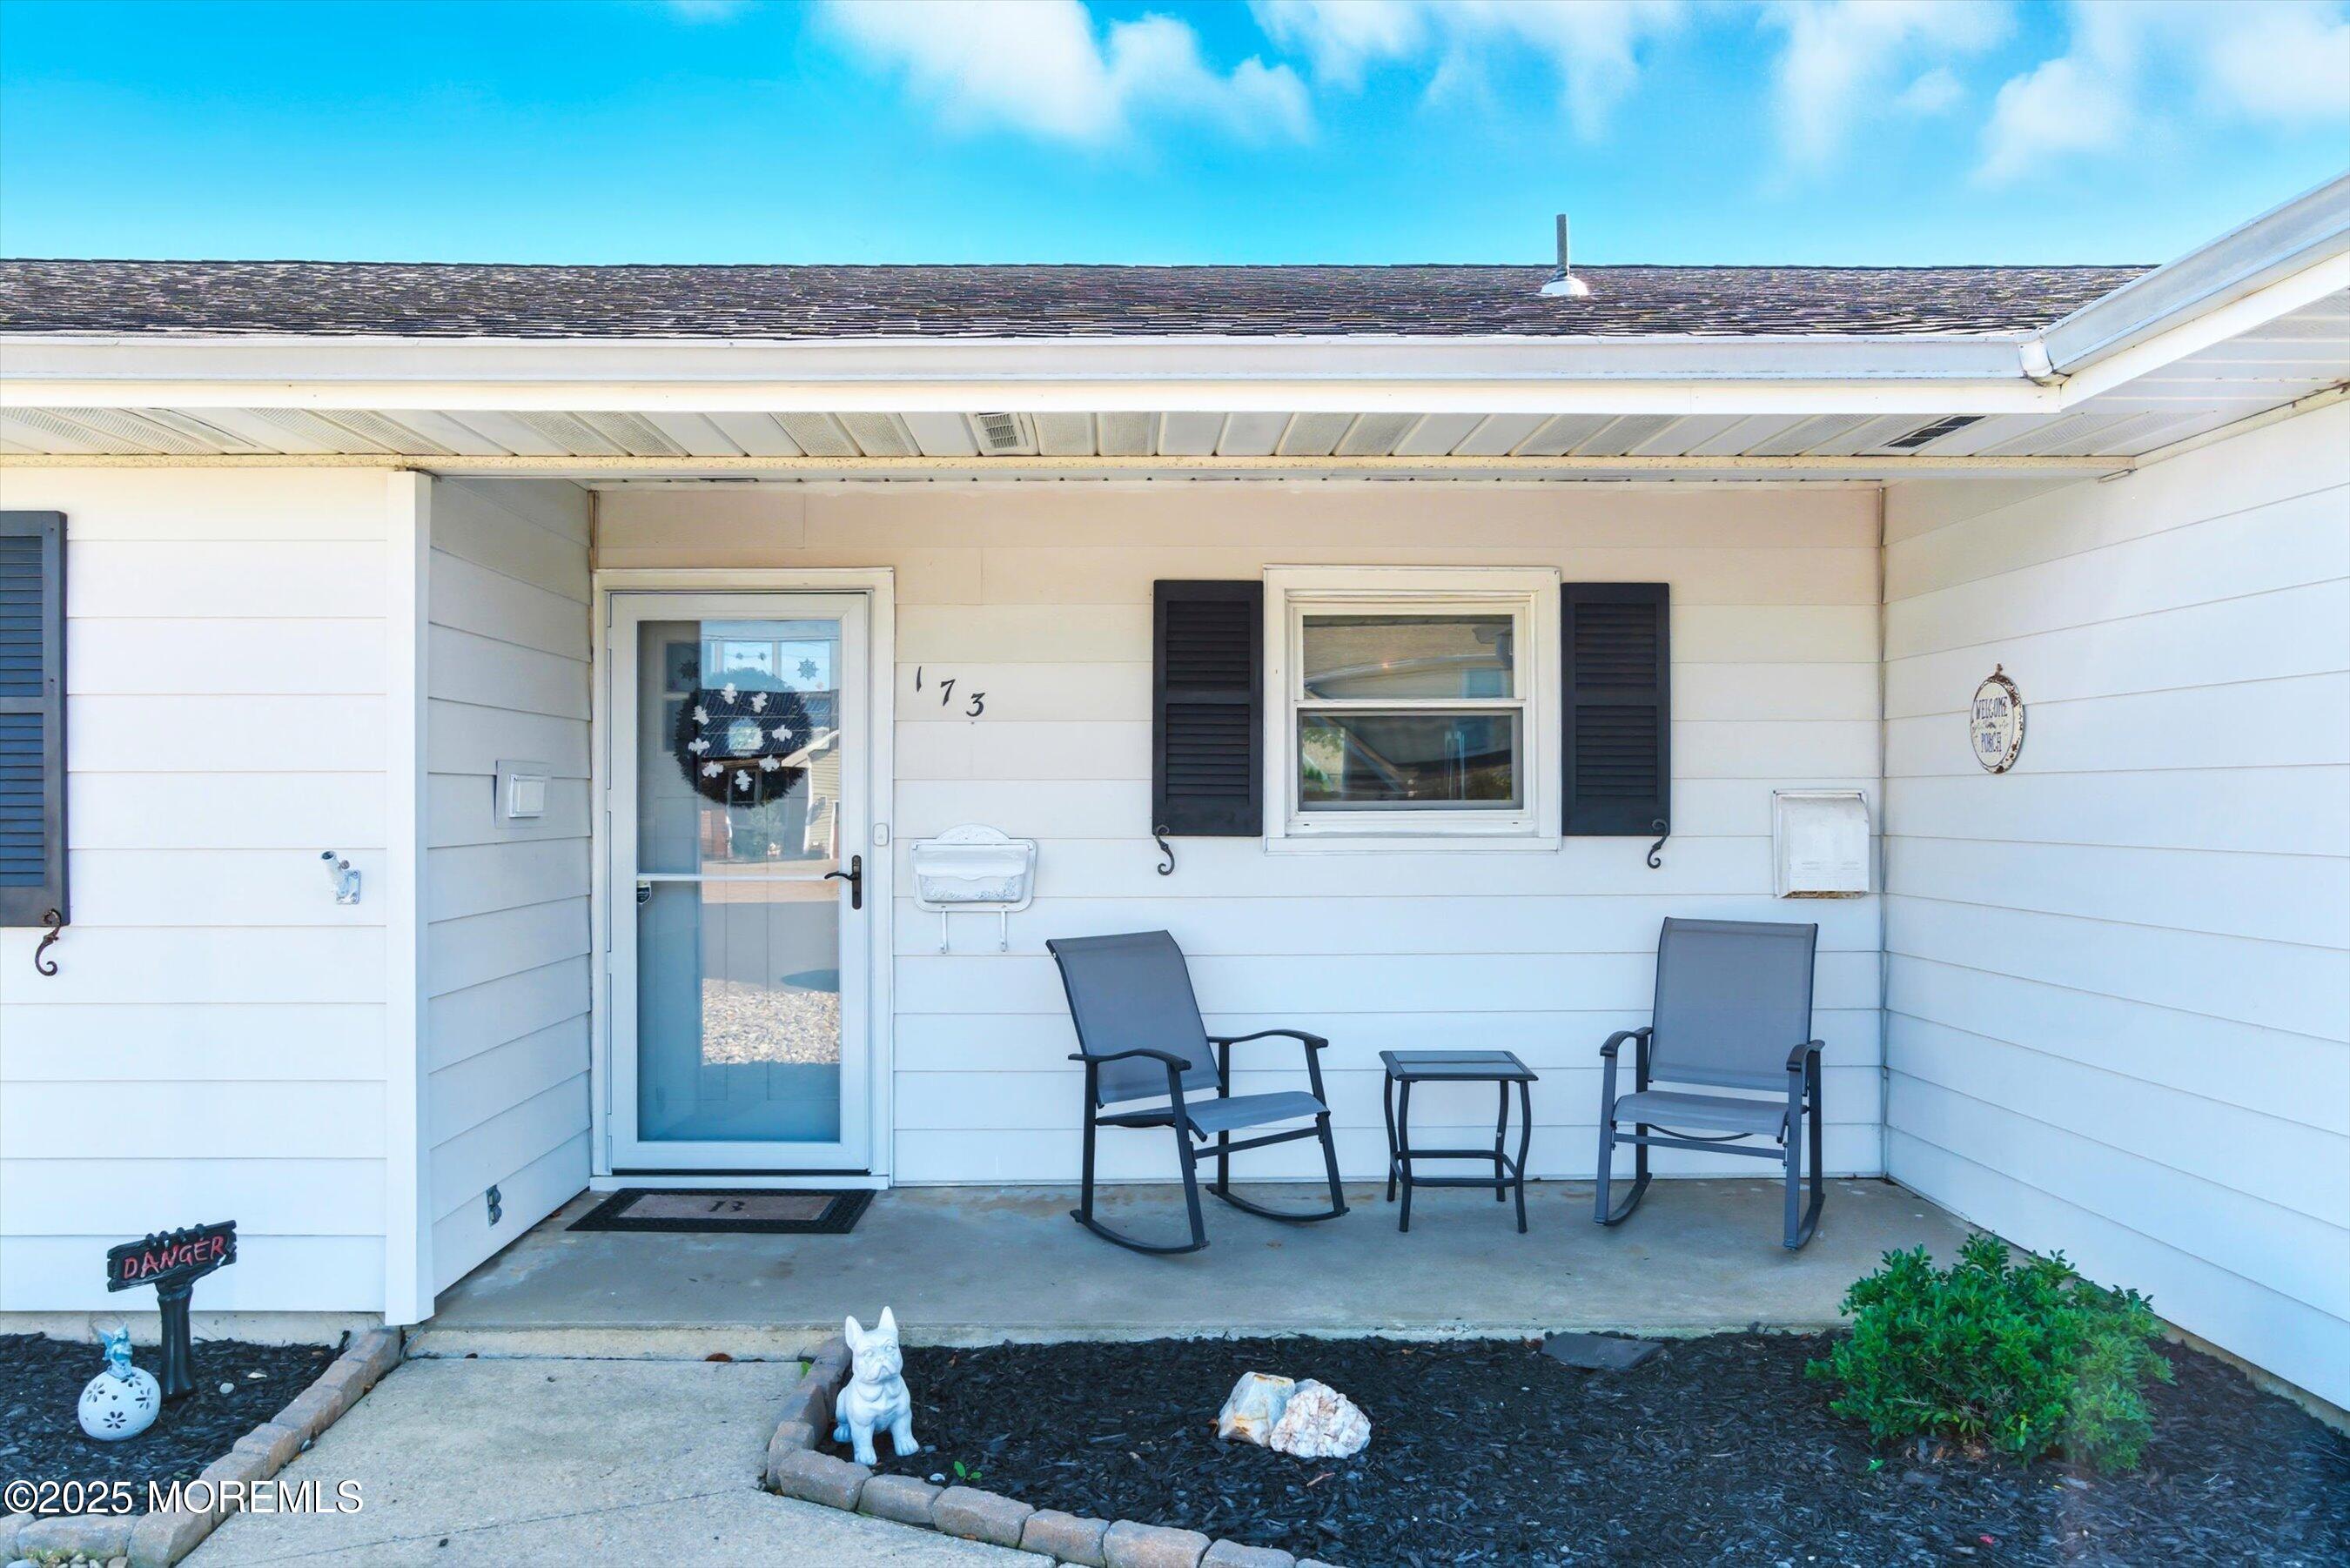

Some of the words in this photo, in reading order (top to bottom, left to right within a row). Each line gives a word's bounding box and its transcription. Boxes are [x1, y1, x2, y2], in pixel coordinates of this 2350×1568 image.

[915, 665, 985, 718] 173
[1976, 696, 2008, 720] WELCOME
[123, 1236, 225, 1280] DANGER
